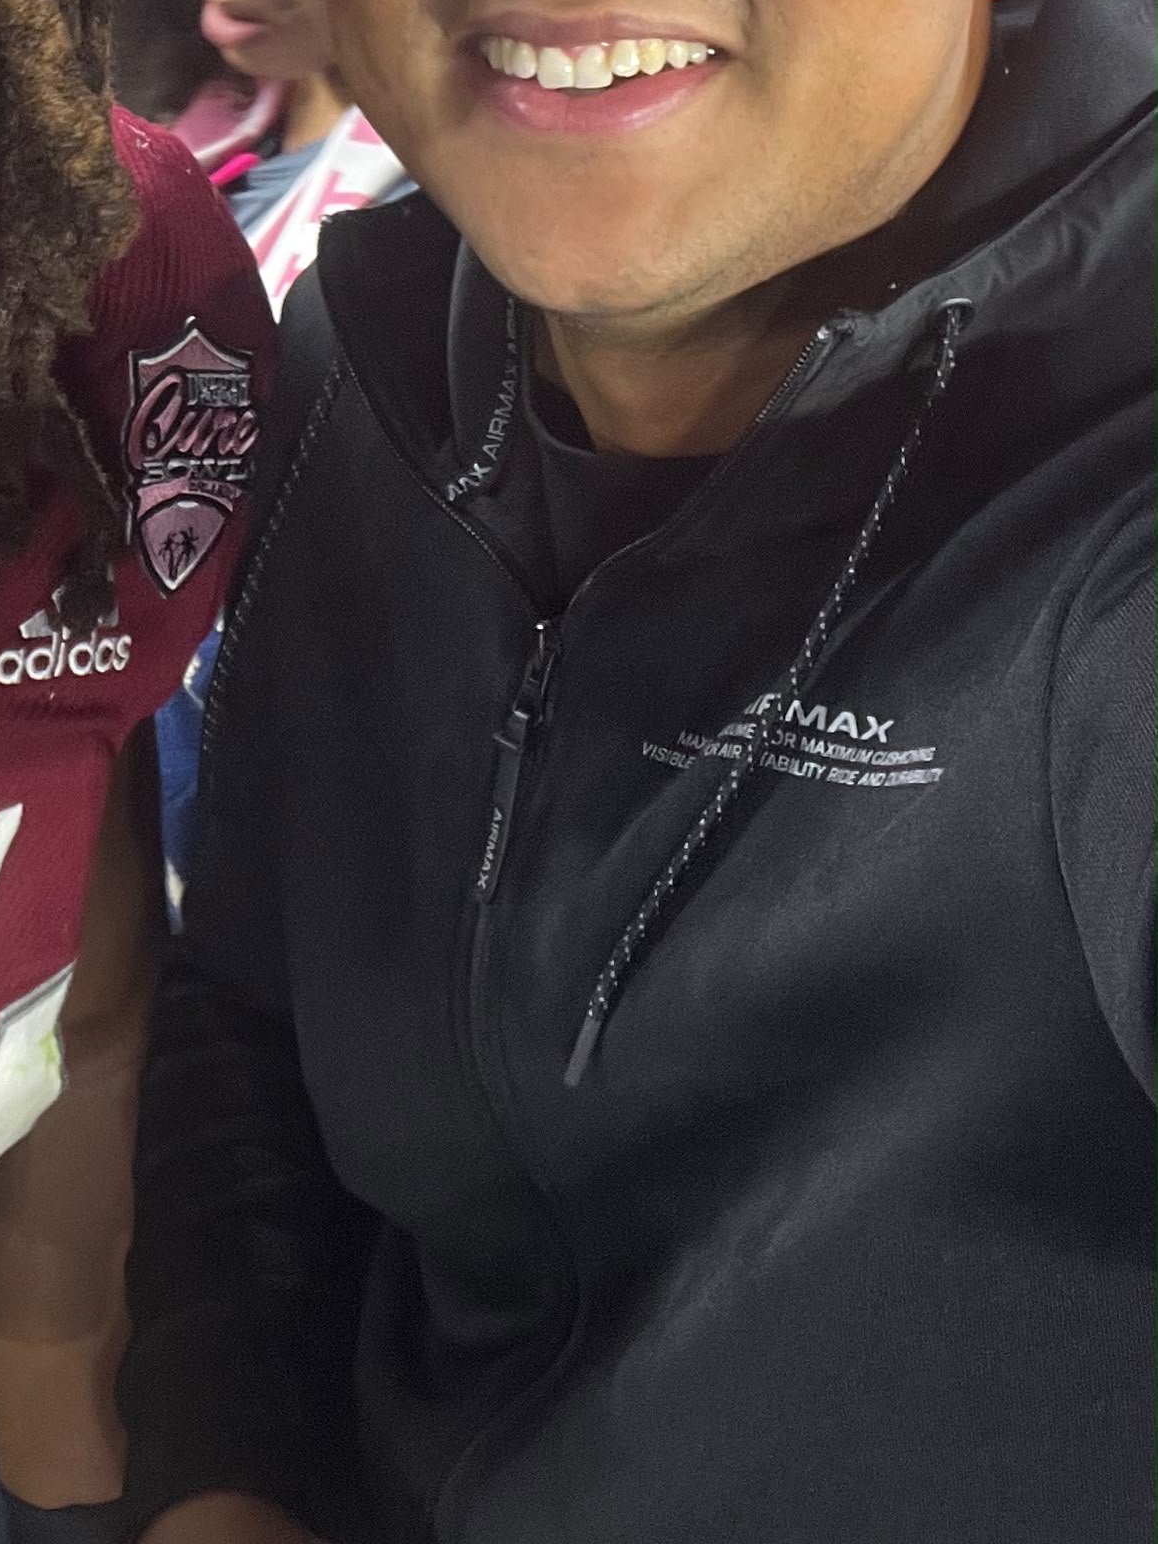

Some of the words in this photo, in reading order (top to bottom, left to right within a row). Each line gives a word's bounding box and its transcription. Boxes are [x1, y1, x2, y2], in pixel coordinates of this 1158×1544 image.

[128, 371, 260, 470] Cure
[785, 699, 895, 743] MAX
[642, 741, 696, 770] VISIBLE
